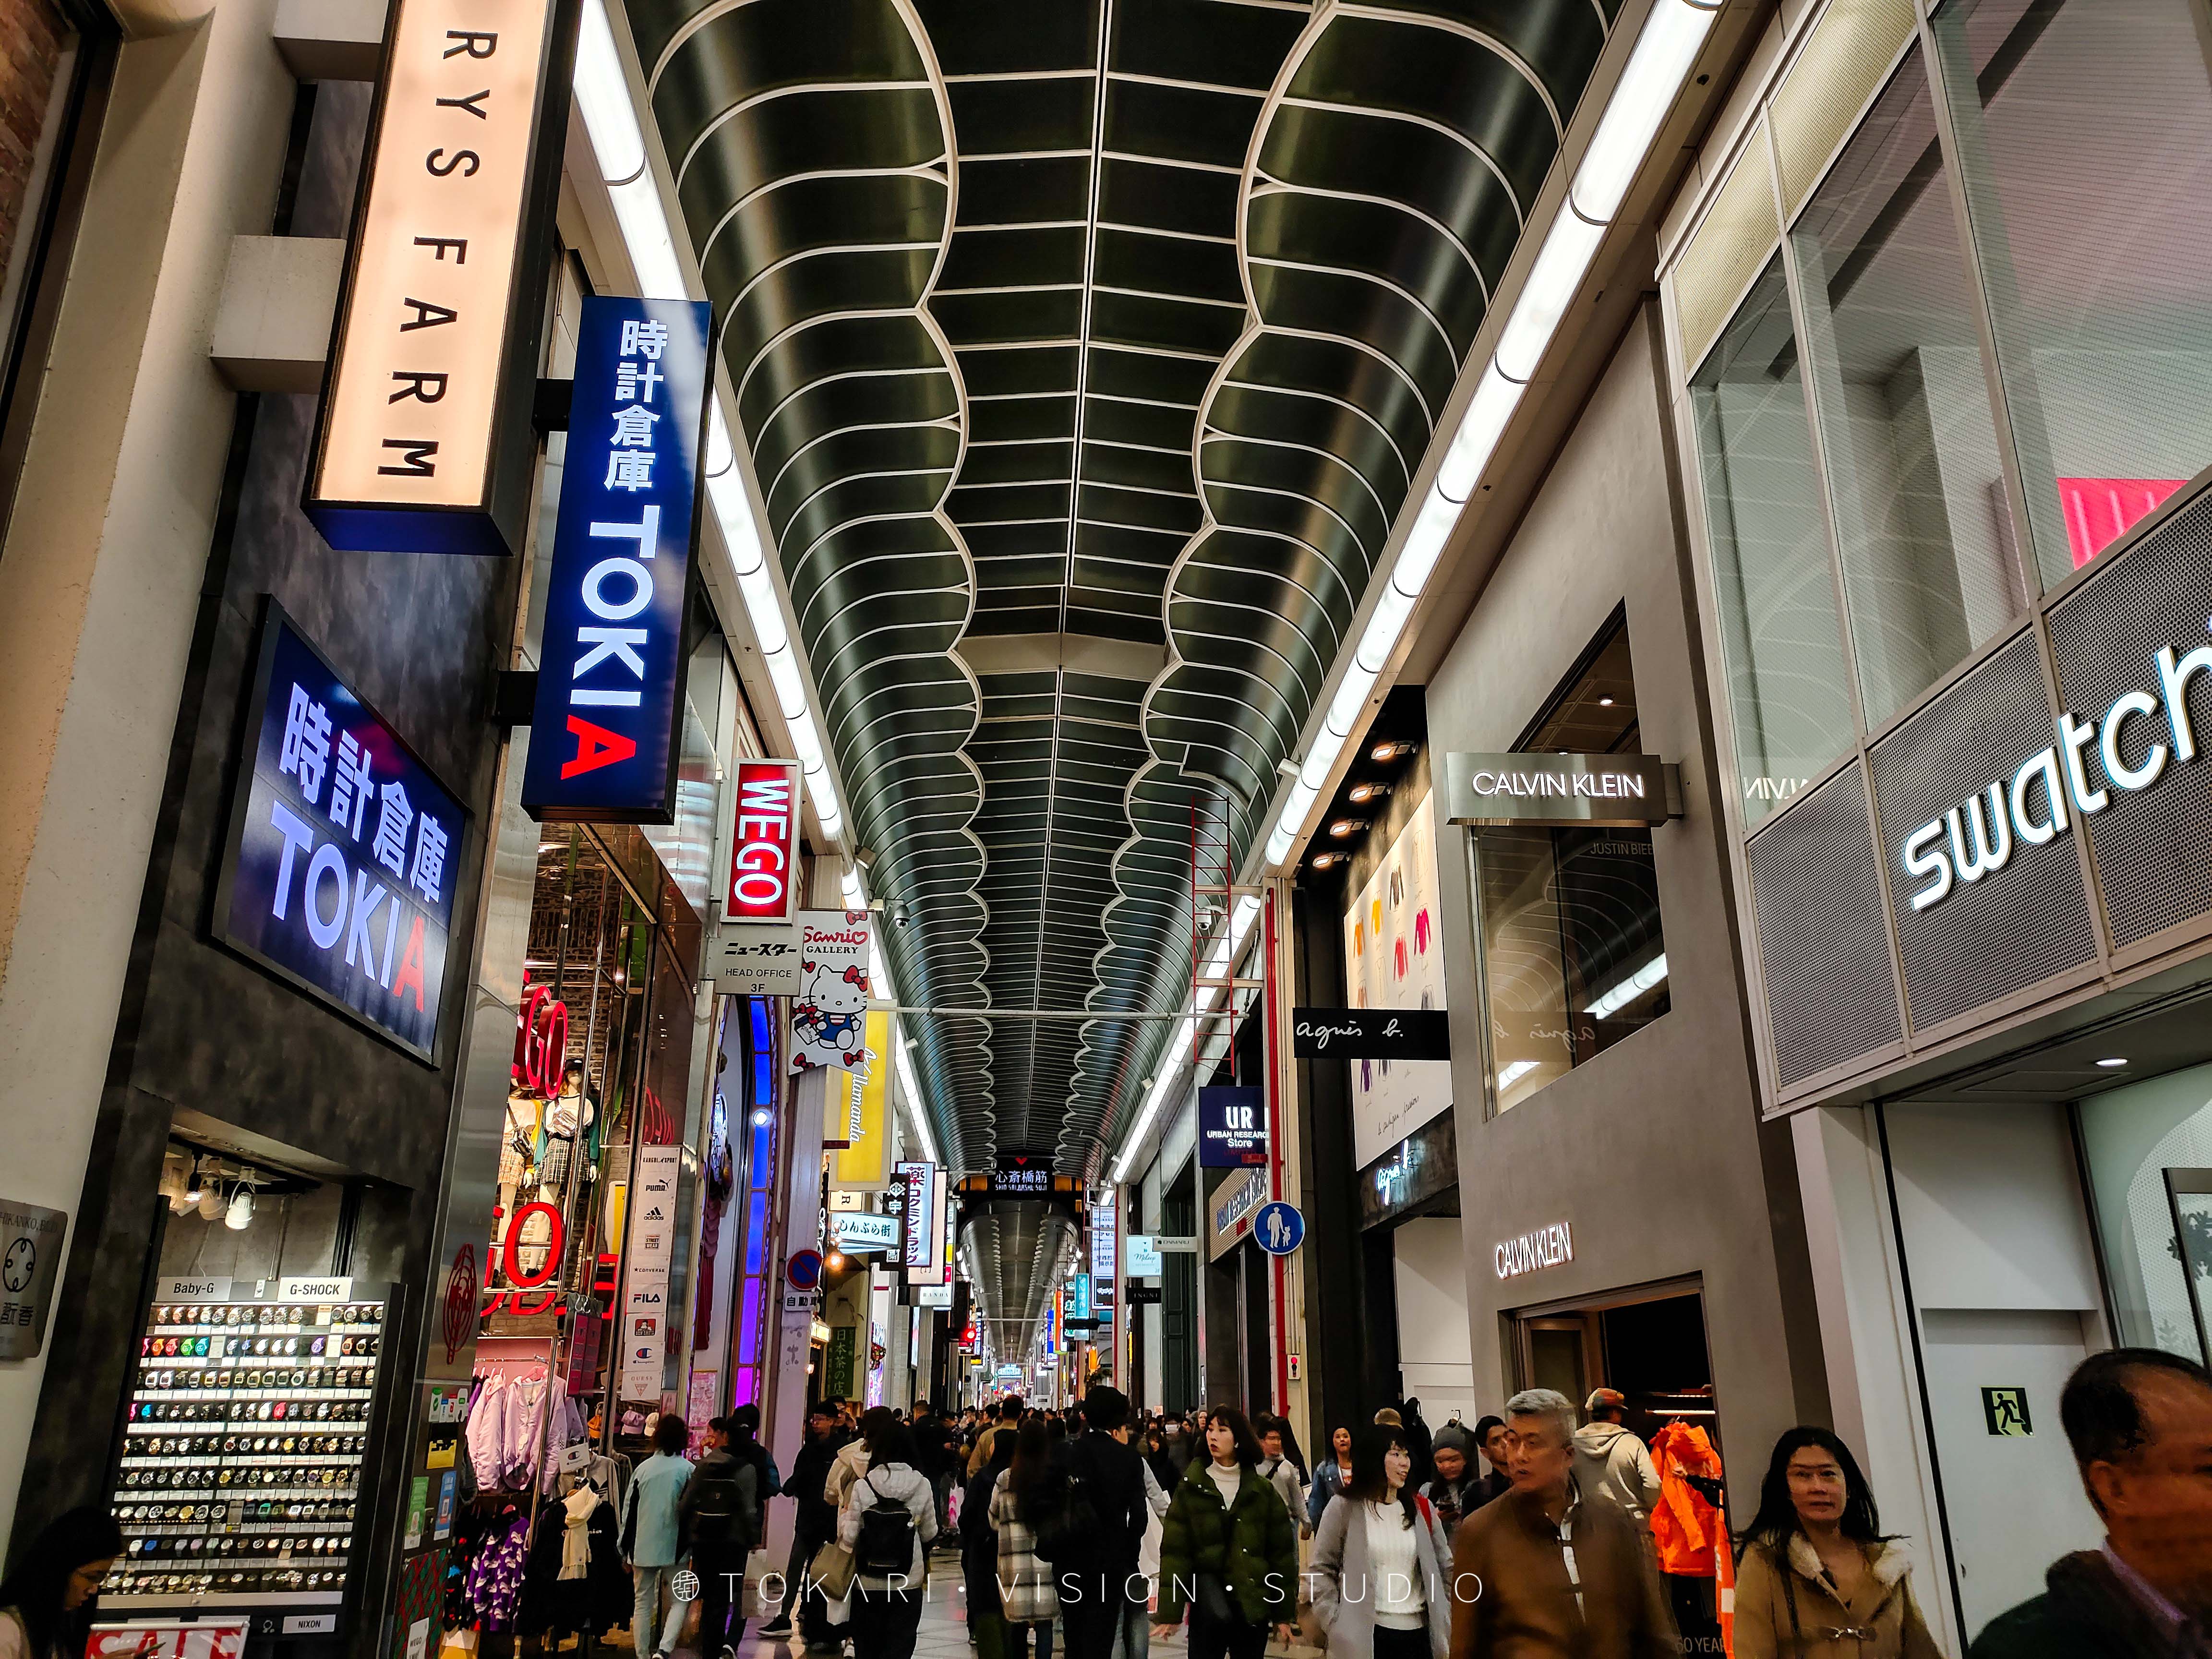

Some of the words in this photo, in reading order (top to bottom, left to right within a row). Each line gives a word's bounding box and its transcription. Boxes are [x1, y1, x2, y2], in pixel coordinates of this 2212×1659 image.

[603, 319, 669, 493] 時計倉庫
[561, 505, 661, 780] TOKIA
[1472, 772, 1566, 796] CALVIN
[1573, 773, 1644, 798] KLEIN
[1904, 645, 2212, 911] swatch
[279, 682, 448, 903] 時計倉庫
[734, 779, 790, 906] WEGO
[1590, 842, 1629, 854] JUSTIN
[271, 800, 425, 1012] TOKIA
[803, 926, 868, 946] Sanrio
[724, 942, 797, 956] ニュースター
[806, 946, 858, 954] GALLERY
[726, 968, 753, 977] HEAD
[756, 969, 792, 978] OFFICE
[751, 984, 765, 992] 3F
[1296, 1021, 1362, 1049] agnès
[1226, 1106, 1253, 1129] UR
[1227, 1138, 1253, 1147] Store
[1234, 1130, 1269, 1139] RESEARC
[906, 1166, 925, 1186] 薬
[995, 1170, 1047, 1183] 心斎橋筋
[840, 1219, 891, 1237] しんぶら街
[1495, 1234, 1536, 1279] CALVIN
[1536, 1222, 1572, 1268] KLEIN
[173, 1277, 214, 1294] Baby-G
[290, 1284, 340, 1295] G-SHOCK
[634, 1294, 661, 1303] FILA
[834, 1330, 846, 1395] 日本茶の店
[298, 1619, 321, 1629] NIXON
